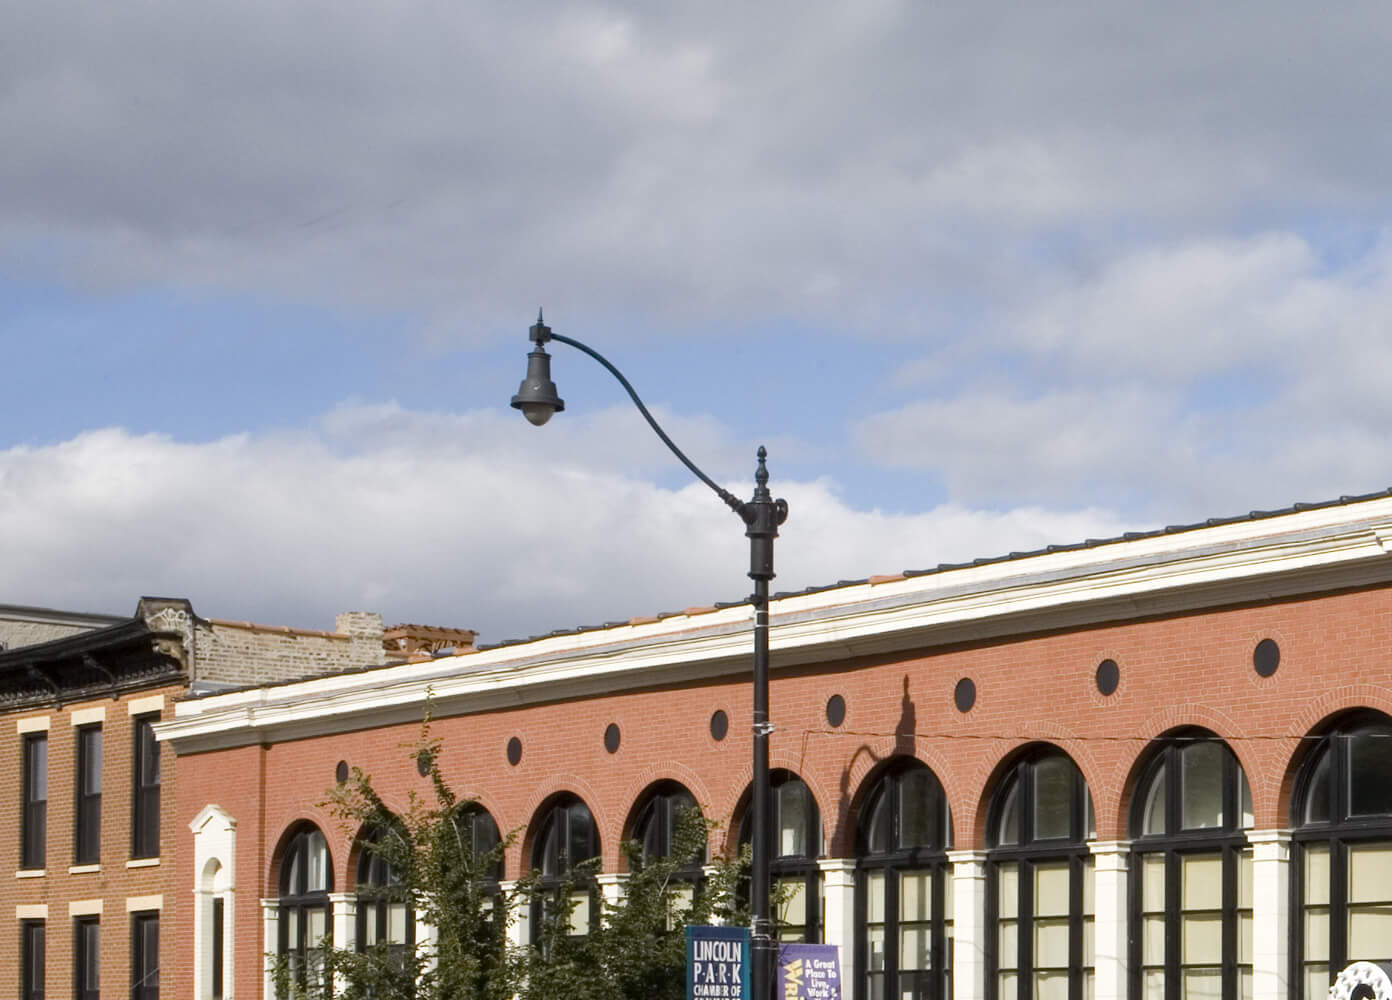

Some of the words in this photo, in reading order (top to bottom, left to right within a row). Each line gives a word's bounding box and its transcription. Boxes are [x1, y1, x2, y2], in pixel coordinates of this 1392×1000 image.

[694, 941, 741, 962] LINCOLN
[693, 984, 729, 996] CHAMBER
[731, 985, 741, 997] OF
